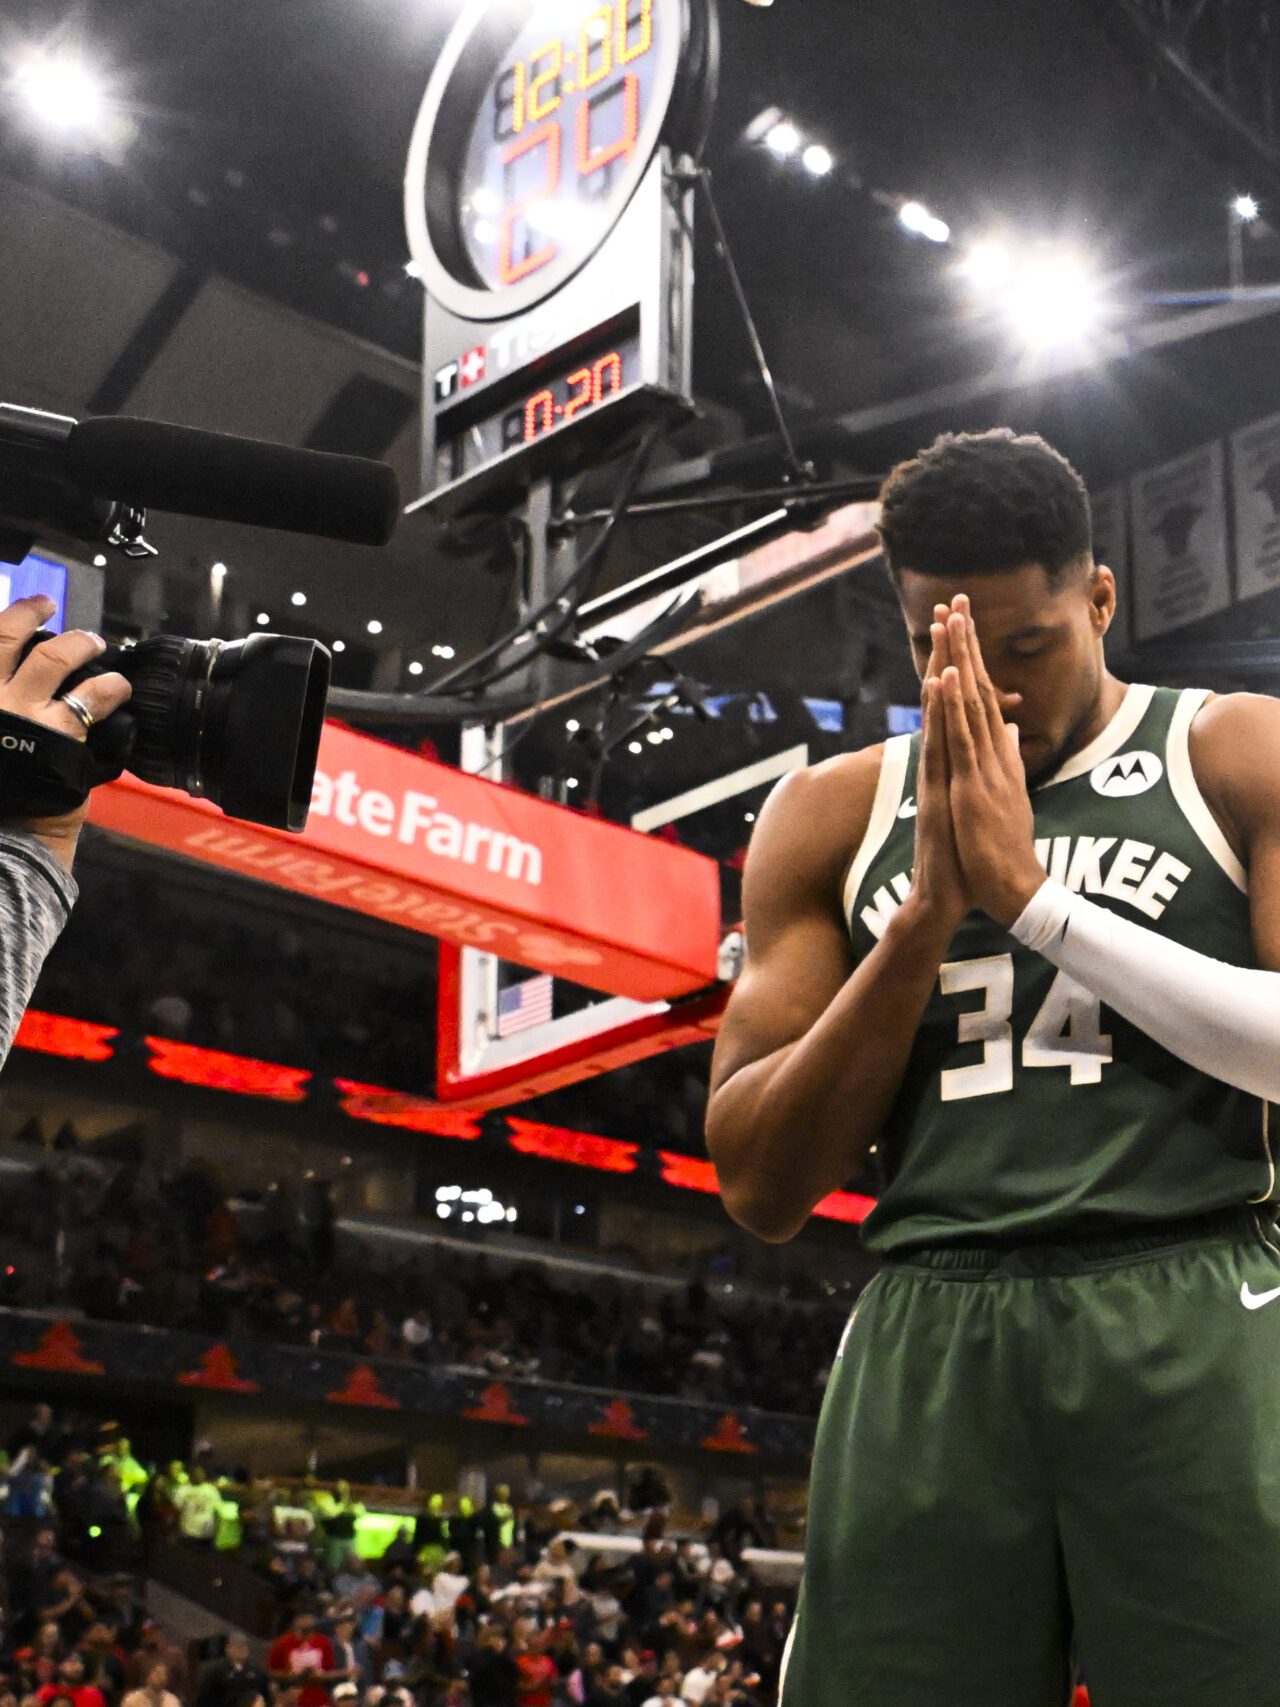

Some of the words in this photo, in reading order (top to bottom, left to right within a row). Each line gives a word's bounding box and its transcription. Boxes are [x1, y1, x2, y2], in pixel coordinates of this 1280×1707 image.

[512, 0, 653, 132] 12:00
[500, 72, 639, 284] 24
[309, 769, 542, 886] ateFarm
[939, 952, 1113, 1102] 34
